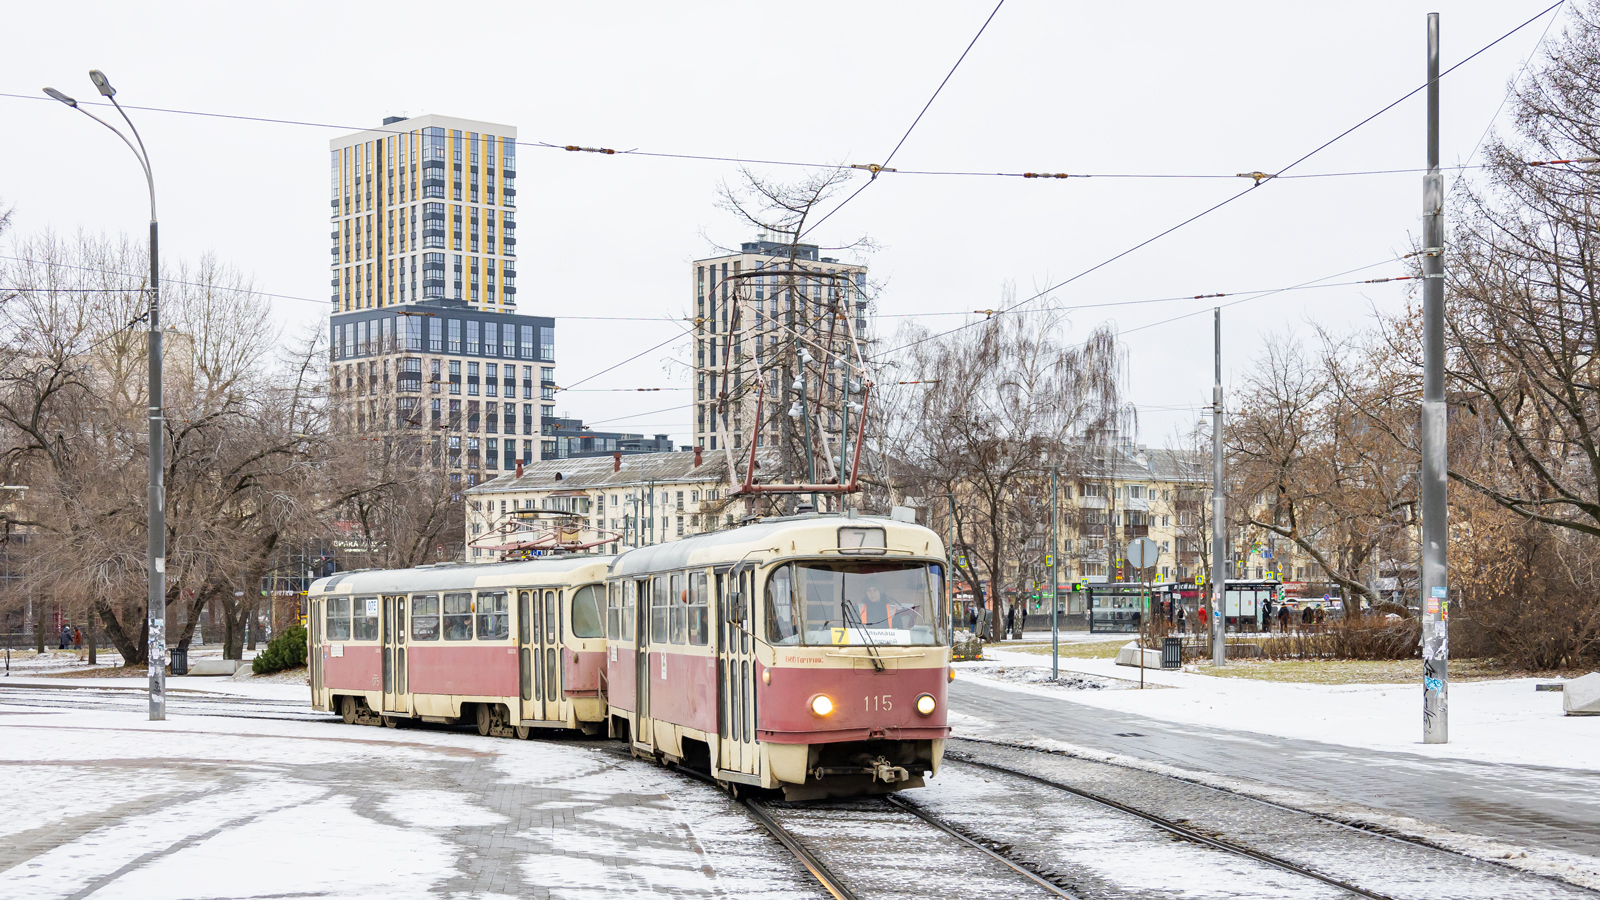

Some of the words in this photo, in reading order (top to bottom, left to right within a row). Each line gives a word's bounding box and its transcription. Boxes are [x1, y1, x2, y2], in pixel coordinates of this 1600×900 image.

[853, 531, 866, 553] 7
[834, 629, 846, 644] 7
[863, 694, 893, 712] 115
